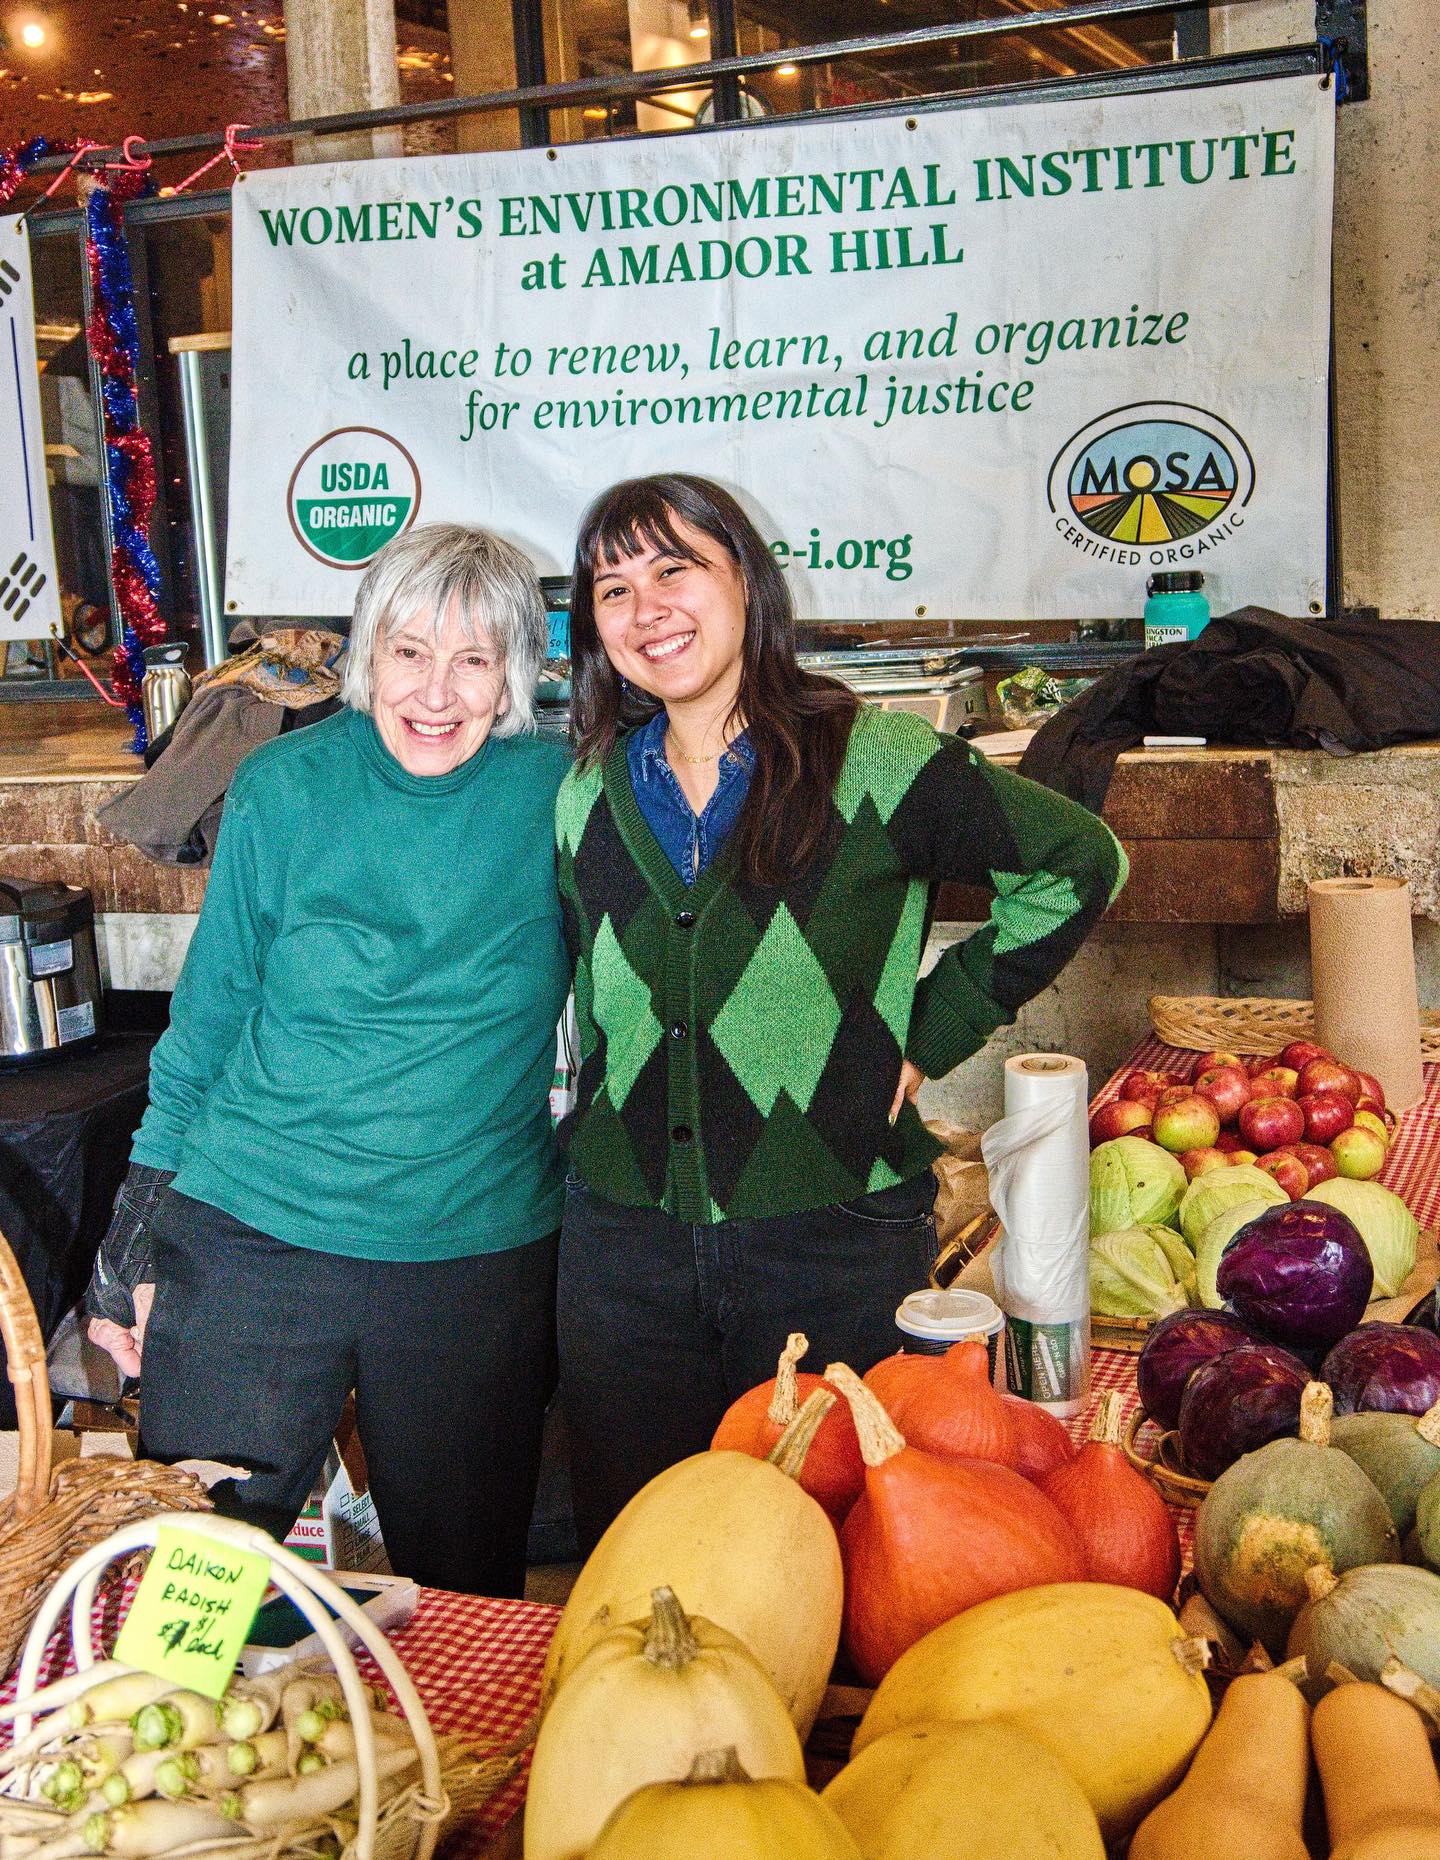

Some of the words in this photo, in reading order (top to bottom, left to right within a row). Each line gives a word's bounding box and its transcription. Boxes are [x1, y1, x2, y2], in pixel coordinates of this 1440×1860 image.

[259, 196, 484, 247] WOMEN’S
[499, 163, 957, 238] ENVIRONMENTAL
[974, 130, 1298, 202] INSTITUTE
[520, 253, 566, 291] at
[580, 234, 813, 289] AMADOR
[829, 223, 965, 274] HILL
[347, 352, 370, 381] a
[381, 338, 478, 391] place
[493, 341, 533, 378] to
[547, 342, 690, 379] renew,
[708, 328, 844, 374] learn,
[863, 312, 960, 364] and
[974, 305, 1191, 364] organize
[460, 389, 520, 442] for
[533, 374, 869, 430] environmental
[873, 370, 1035, 429] justice
[321, 462, 389, 492] USDA
[1080, 451, 1228, 495] MOSA
[309, 503, 397, 529] ORGANIC
[1055, 517, 1141, 566] CERTIFIED
[1149, 512, 1245, 566] ORGANIC
[1038, 1371, 1051, 1399] OPEN
[167, 1547, 243, 1584] DAIKON
[162, 1582, 232, 1616] RADISH
